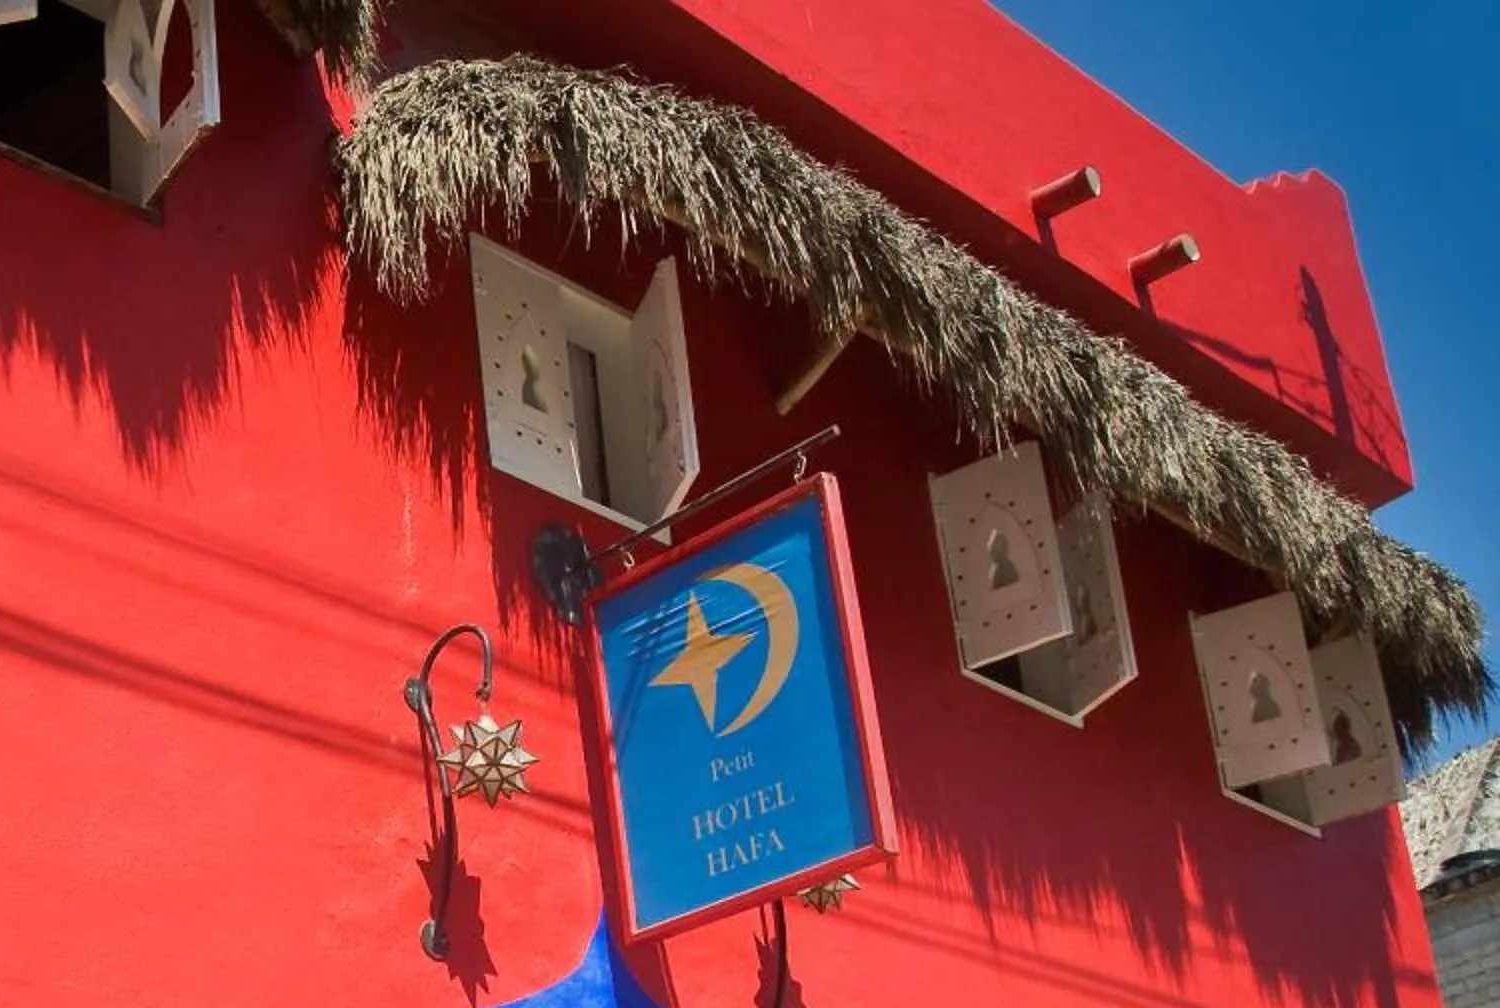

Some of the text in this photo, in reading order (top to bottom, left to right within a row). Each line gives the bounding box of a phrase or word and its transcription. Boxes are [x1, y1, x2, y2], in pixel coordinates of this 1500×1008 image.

[710, 748, 756, 782] Petit
[692, 781, 795, 840] HOTEL
[707, 828, 785, 877] HAFA
